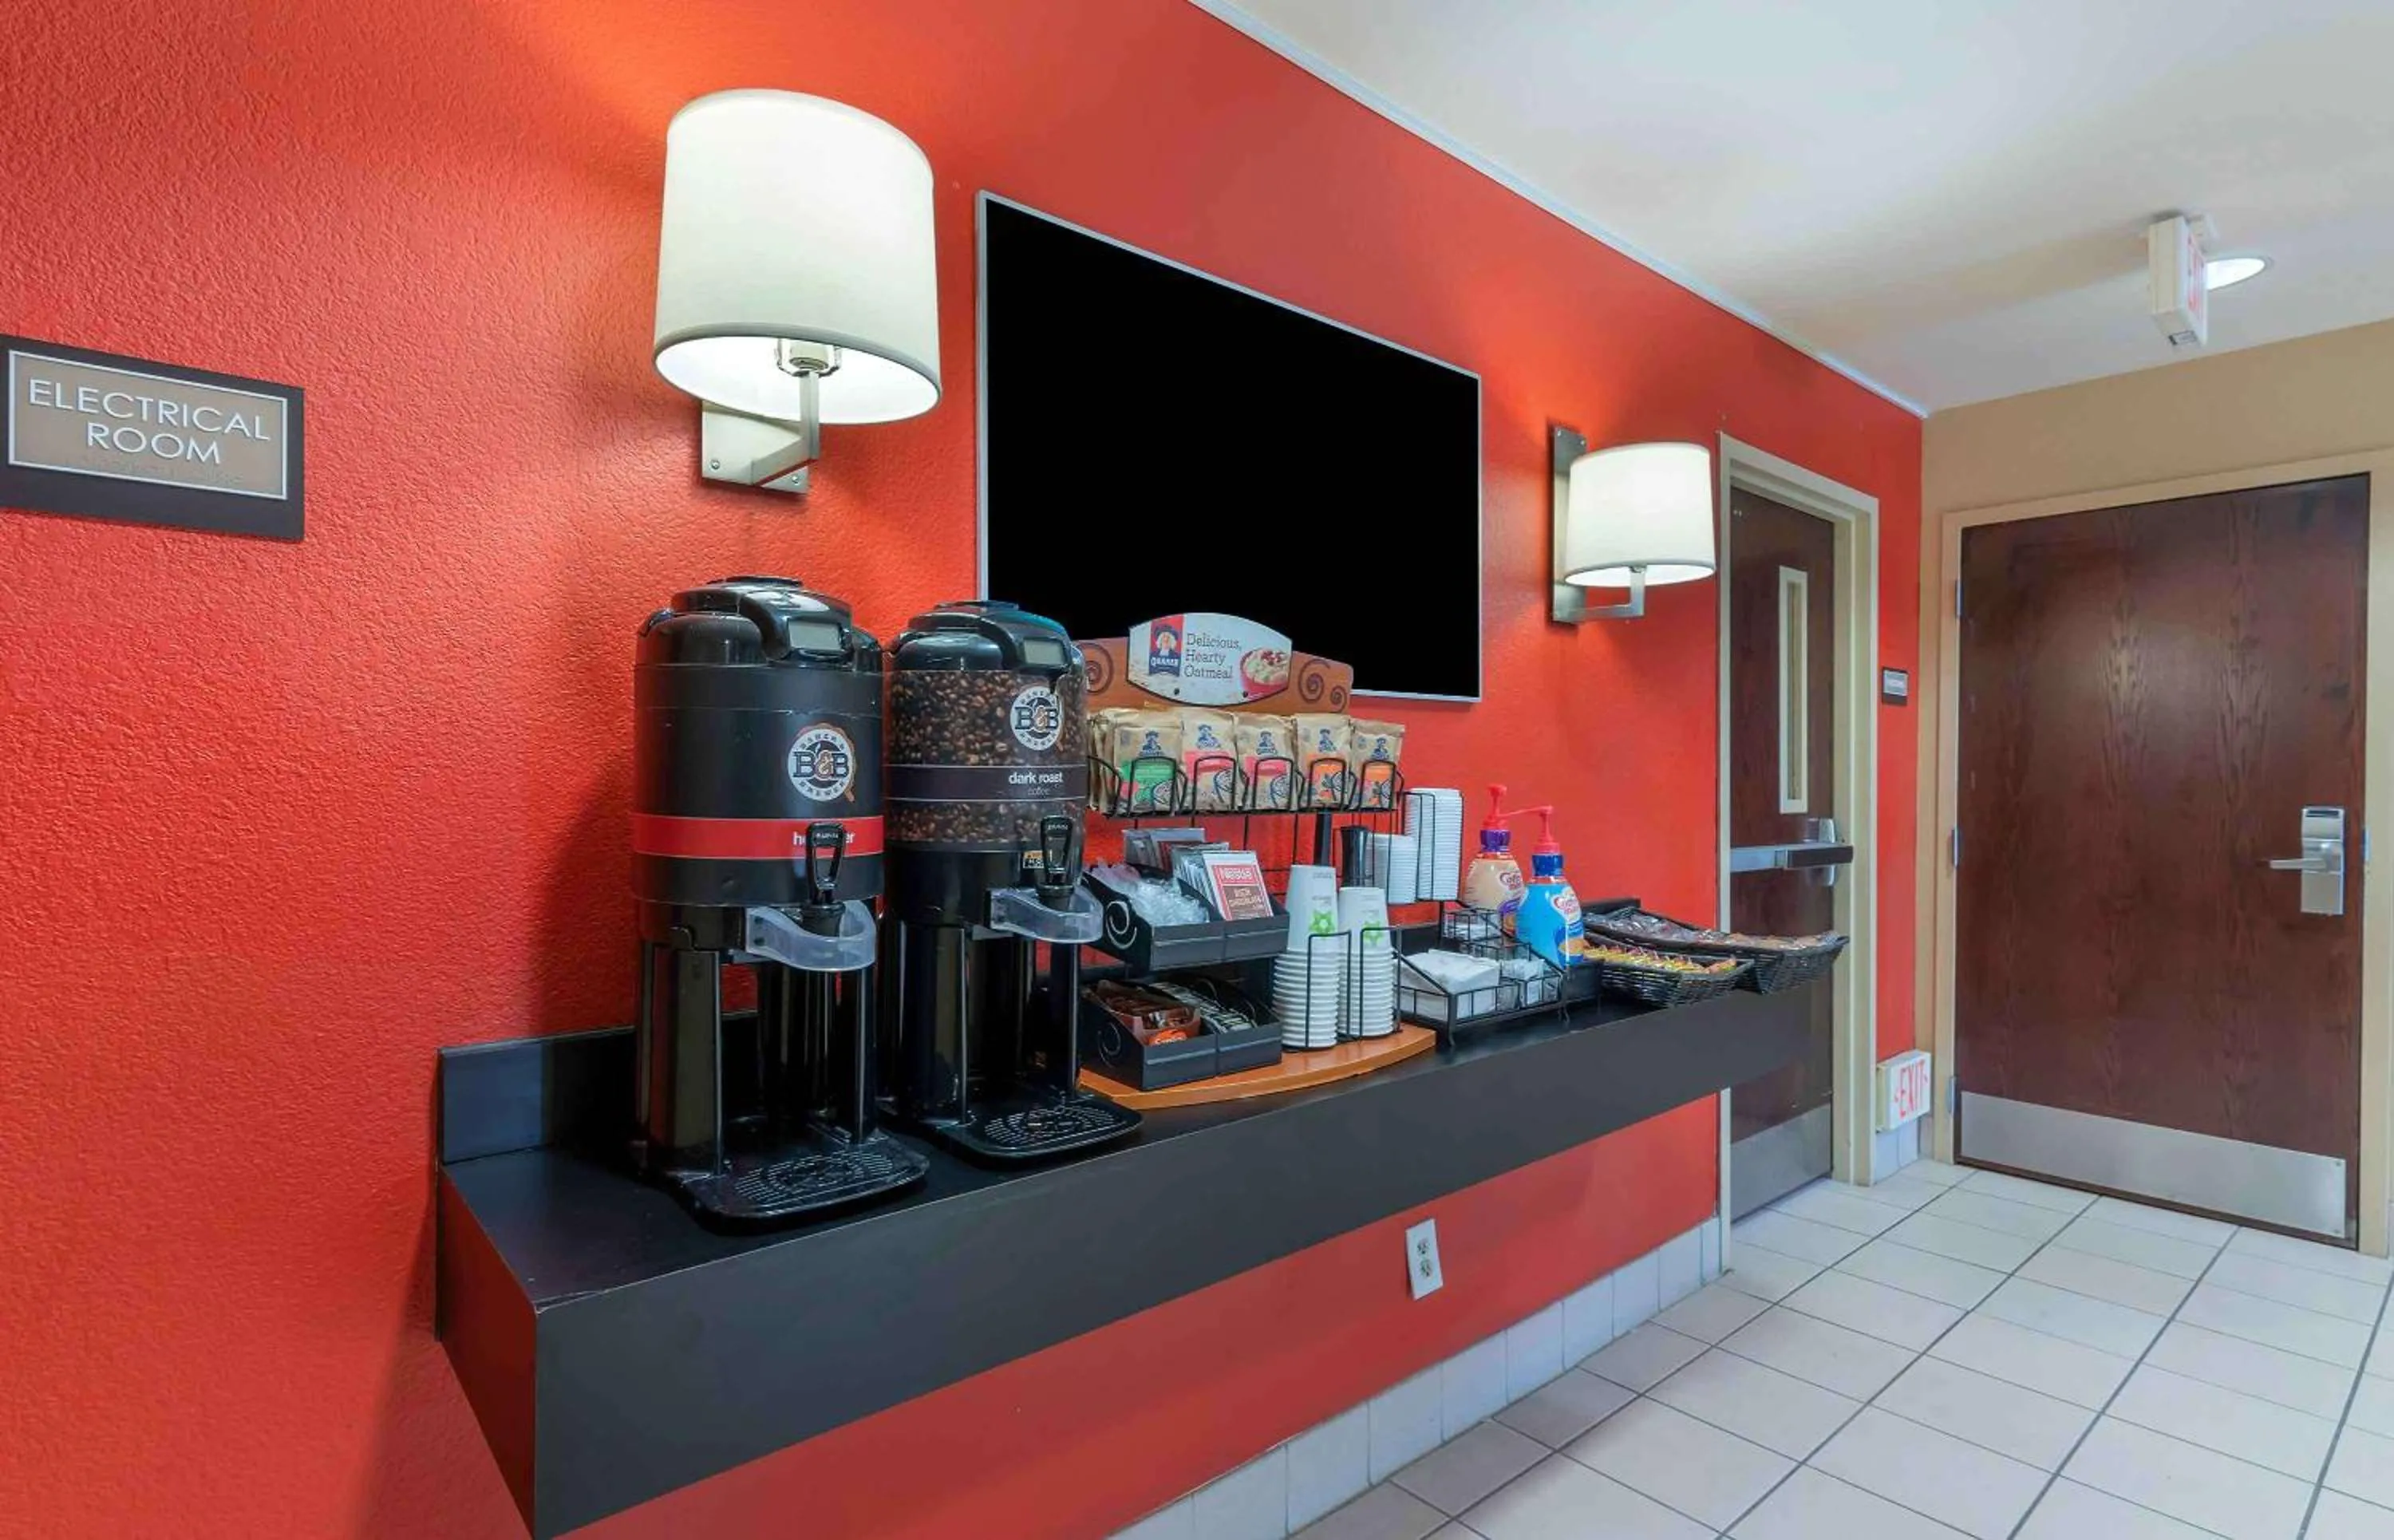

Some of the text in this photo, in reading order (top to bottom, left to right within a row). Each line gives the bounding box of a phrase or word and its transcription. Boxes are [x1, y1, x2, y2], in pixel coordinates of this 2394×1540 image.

[29, 378, 271, 441] ELECTRICAL
[87, 421, 222, 464] ROOM
[1186, 632, 1242, 651] Delicious,
[1186, 648, 1227, 665] Hearty
[1183, 664, 1234, 679] Oatmeal
[1008, 771, 1064, 784] dark roast
[1898, 1058, 1925, 1119] EXIT
